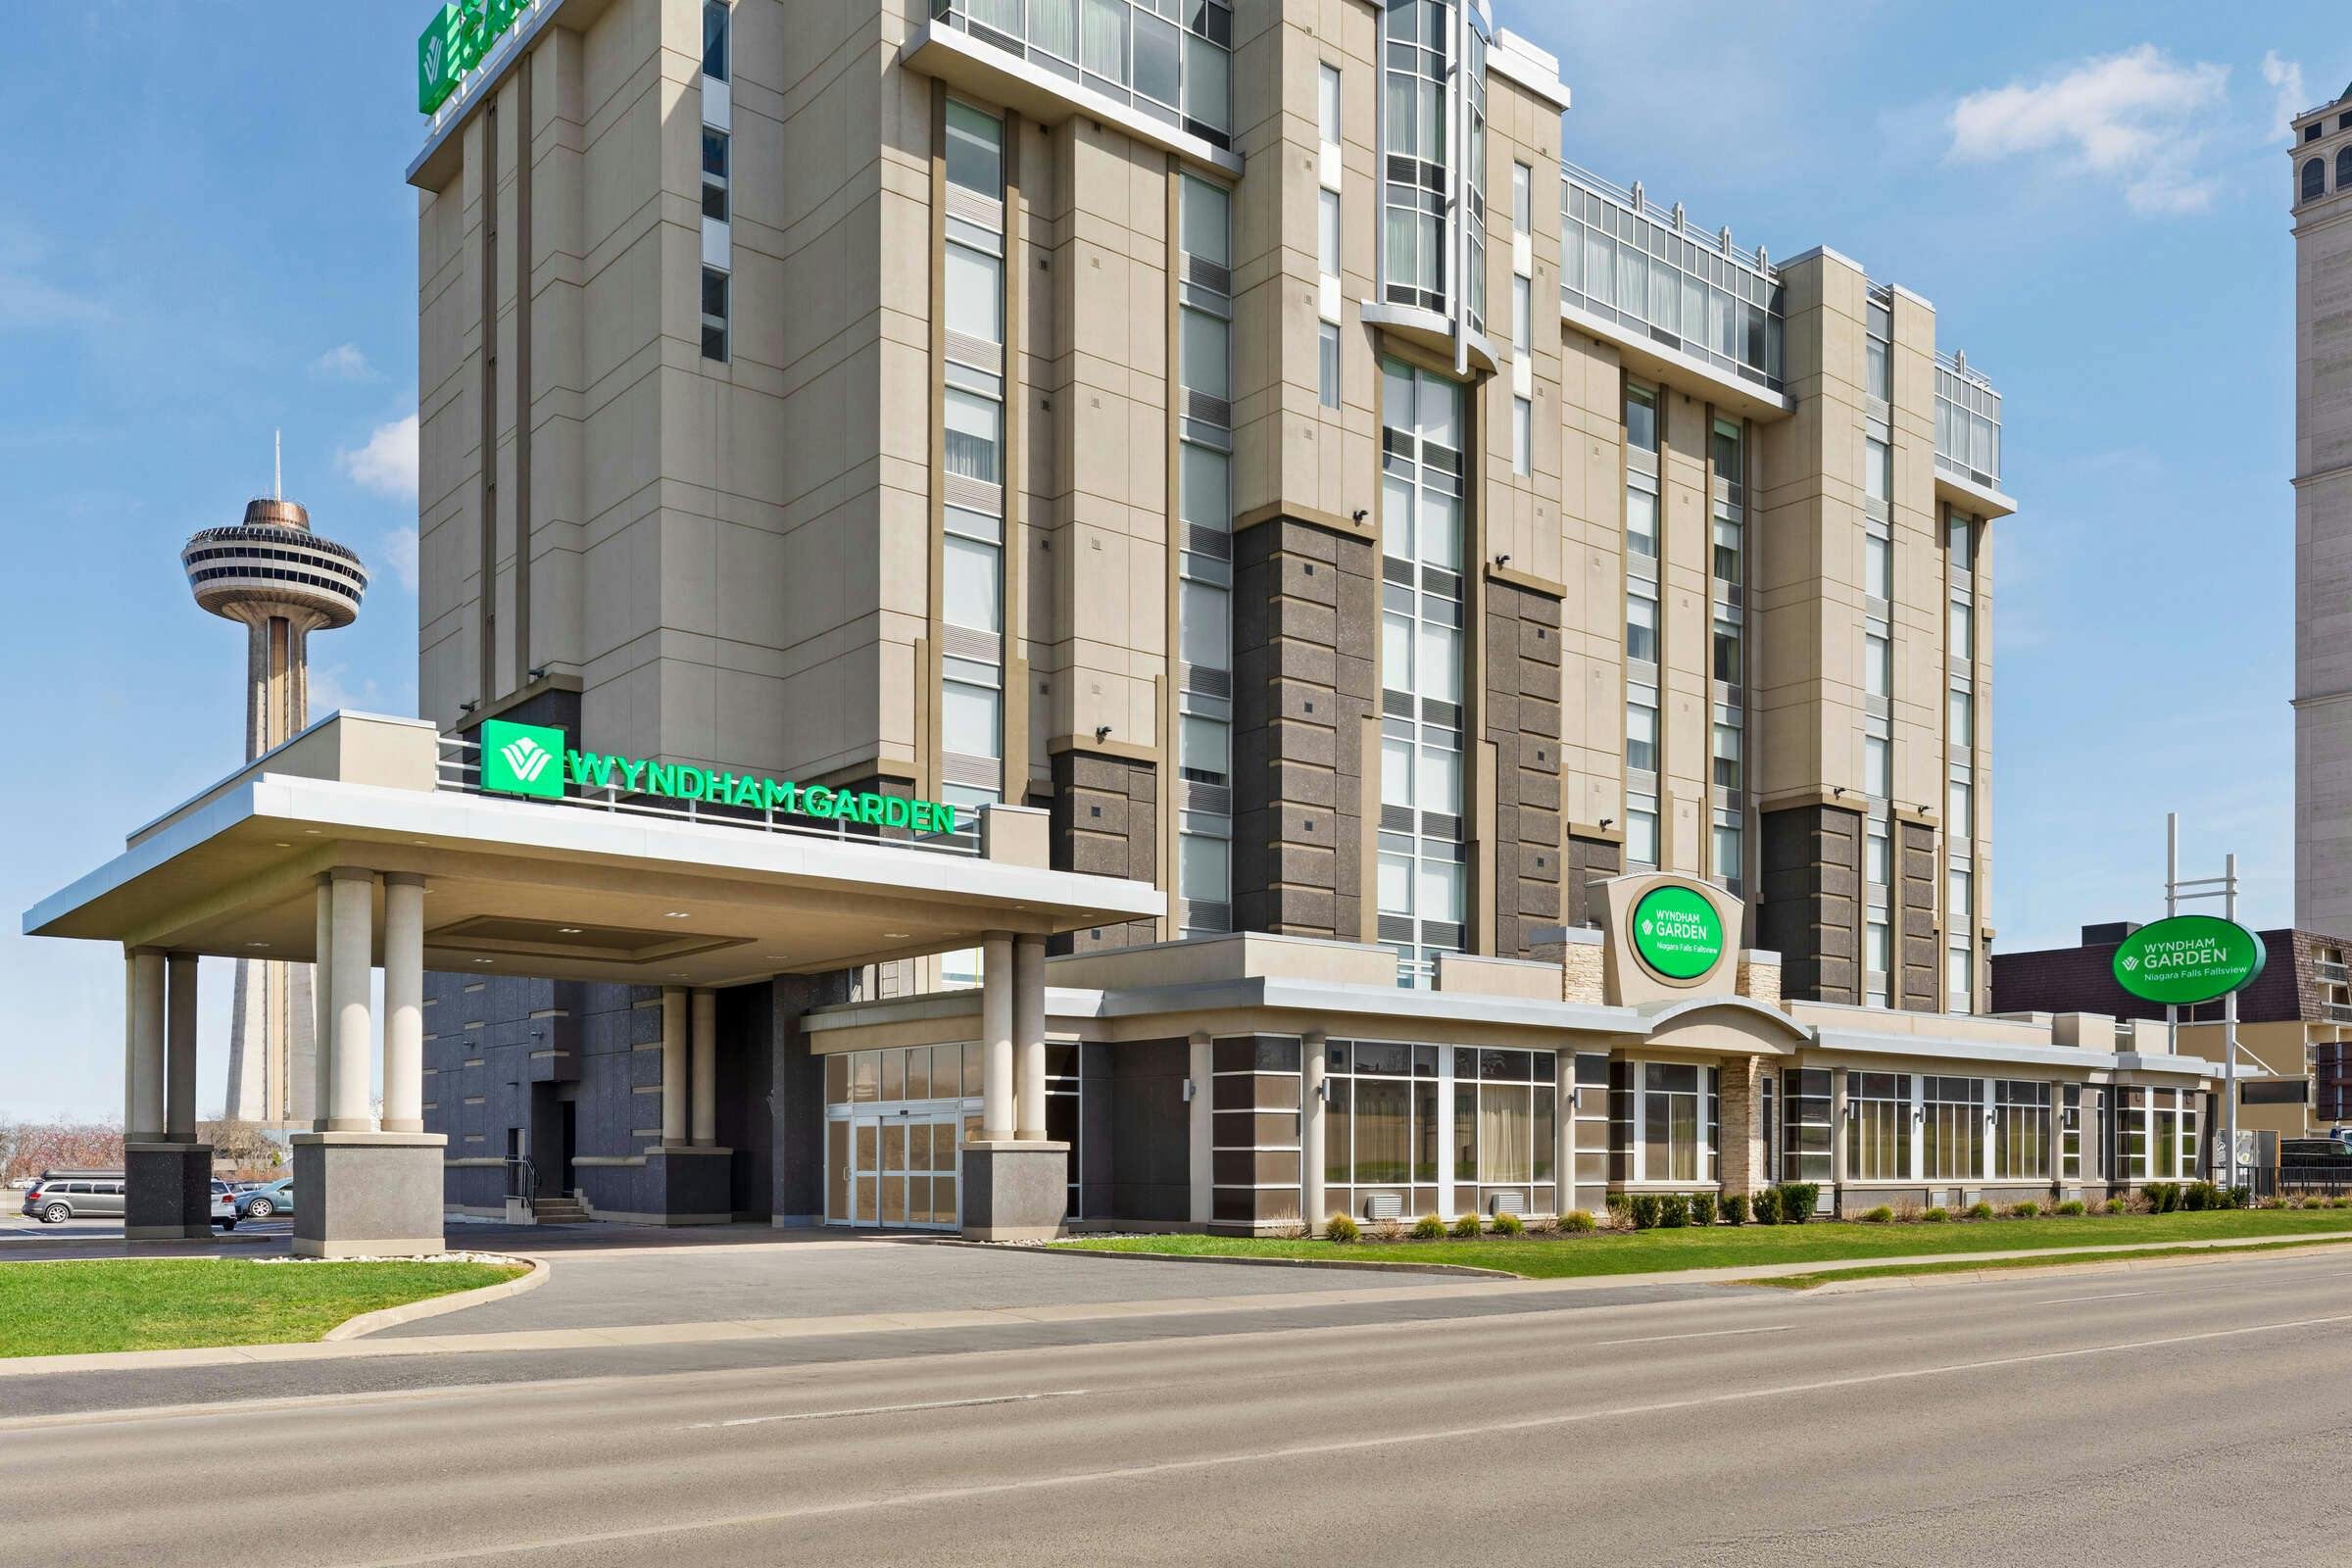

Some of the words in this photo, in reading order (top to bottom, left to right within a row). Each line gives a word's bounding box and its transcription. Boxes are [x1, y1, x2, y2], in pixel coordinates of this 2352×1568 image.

[566, 749, 796, 812] WYNDHAM
[801, 784, 955, 834] GARDEN
[1656, 909, 1699, 923] WYNDHAM
[1656, 921, 1707, 940] GARDEN
[2144, 937, 2216, 954] WYNDHAM
[2143, 948, 2228, 969] GARDEN
[2144, 971, 2180, 981] Niagara
[2204, 966, 2247, 976] Fallsview
